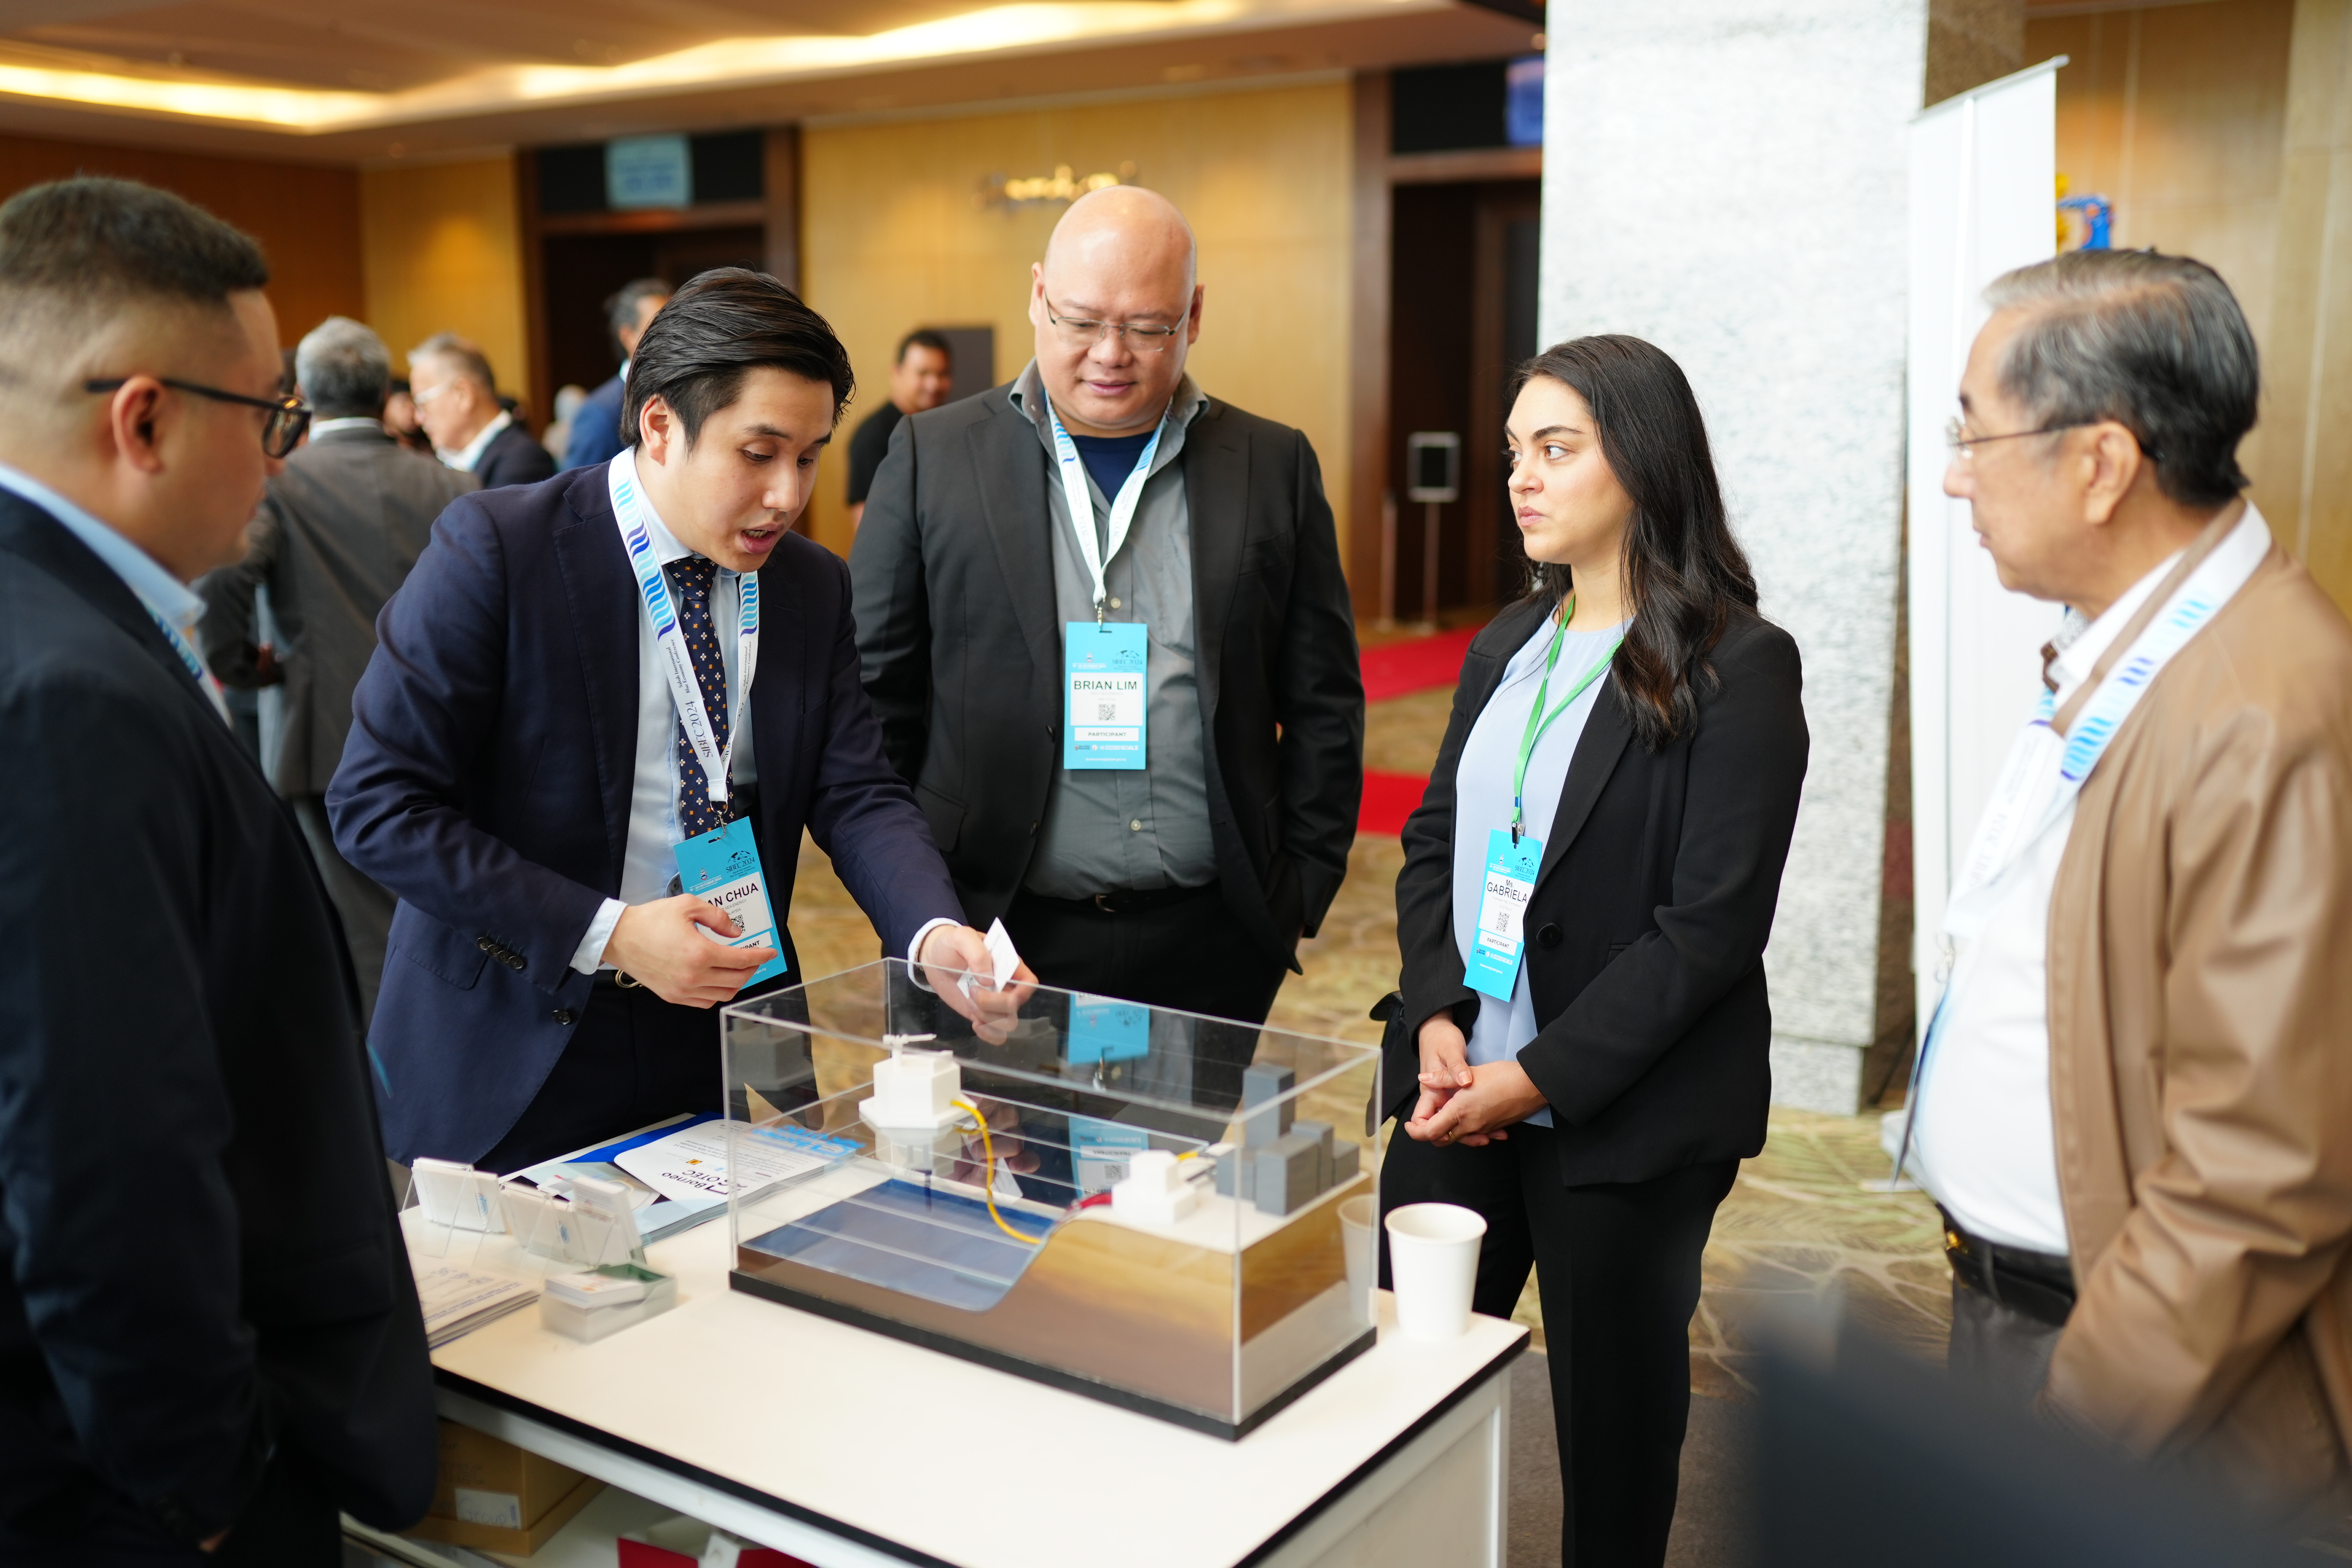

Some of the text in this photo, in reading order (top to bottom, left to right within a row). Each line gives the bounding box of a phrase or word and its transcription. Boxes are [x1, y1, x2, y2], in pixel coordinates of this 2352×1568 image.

[671, 639, 681, 663] Conference
[666, 647, 678, 674] International
[678, 663, 688, 683] Economy
[1074, 680, 1137, 690] BRIAN LIM
[700, 880, 714, 888] OCTOBER
[1505, 879, 1514, 888] Ms.
[707, 896, 723, 907] AN
[726, 883, 759, 902] CHUA
[1487, 882, 1527, 903] GABRIELA
[732, 899, 747, 907] ENERGY
[727, 908, 742, 916] ALAYSIA
[1487, 937, 1509, 948] PARTICIPANT
[1502, 957, 1513, 965] GOALS
[662, 1172, 707, 1188] Borneo
[682, 1170, 720, 1182] OTEC
[450, 1298, 475, 1310] CONTACT
[438, 1462, 486, 1485] TEC
